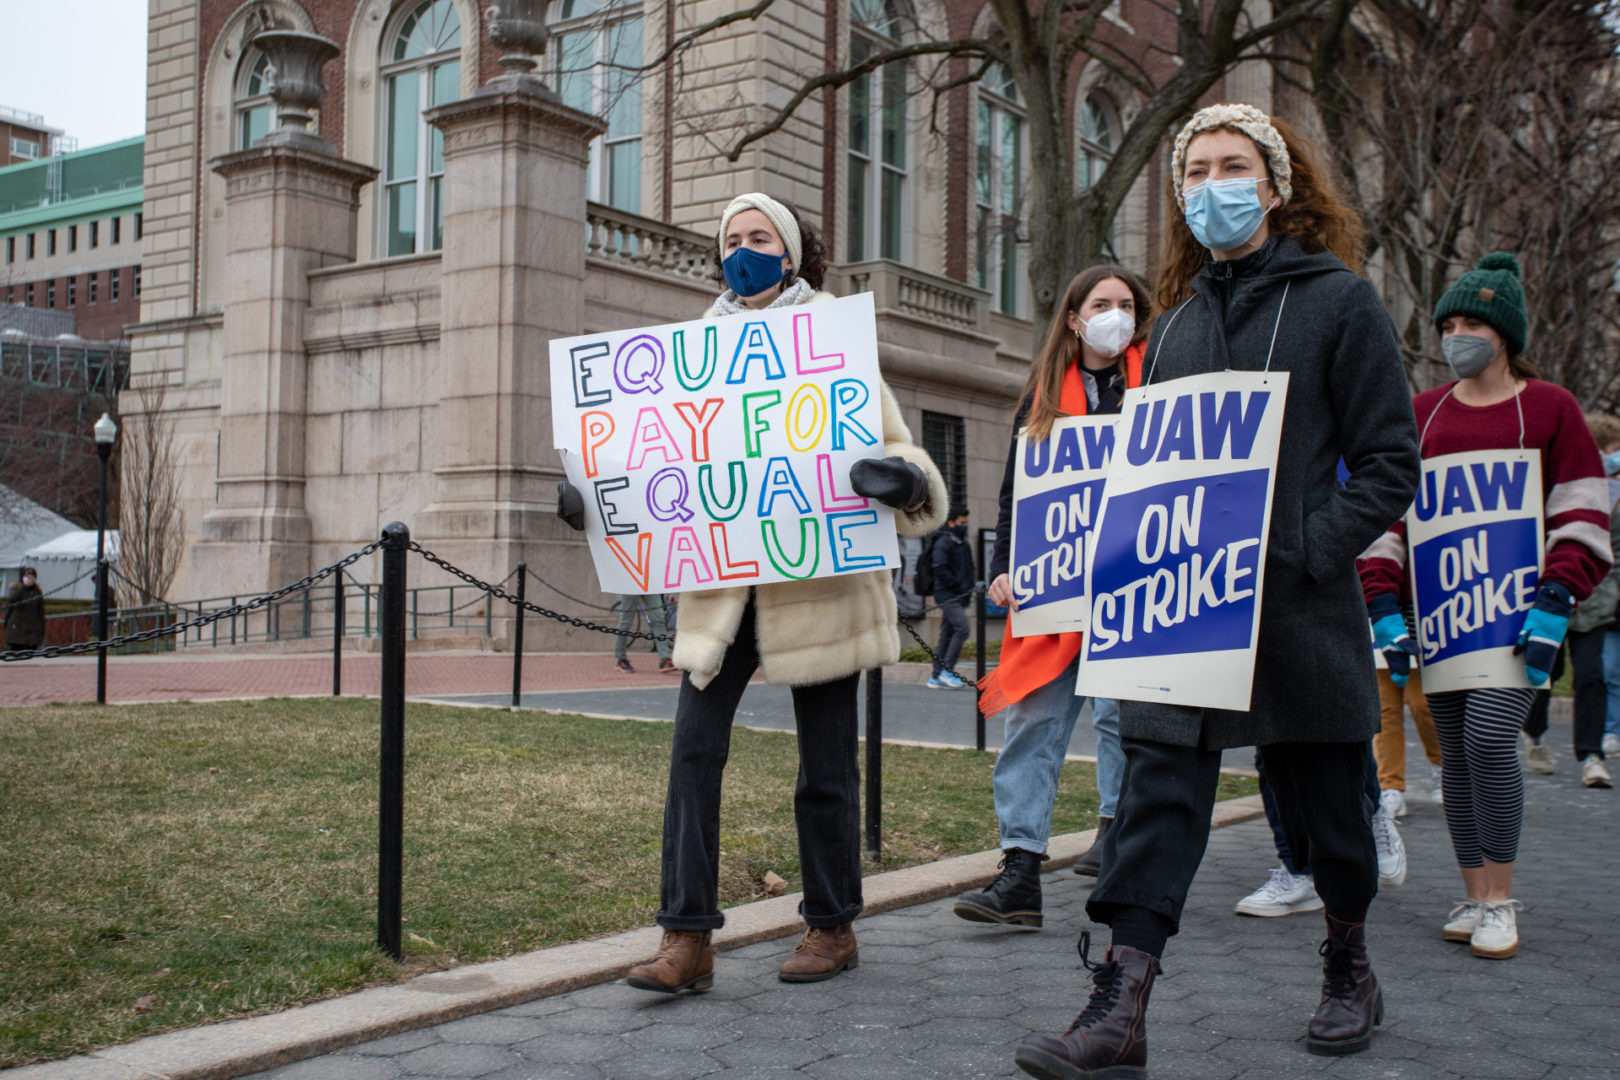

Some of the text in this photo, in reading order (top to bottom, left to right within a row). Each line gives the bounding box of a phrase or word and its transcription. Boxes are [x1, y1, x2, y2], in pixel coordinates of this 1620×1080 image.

[569, 313, 845, 408] EQUAL
[580, 378, 878, 480] PAY FOR
[1126, 391, 1271, 467] UAW
[593, 453, 869, 537] EQUAL
[1045, 486, 1092, 543] ON
[1136, 485, 1206, 565] ON
[1414, 461, 1529, 522] UAW
[604, 509, 886, 592] VALUE
[1439, 529, 1489, 592] ON
[1090, 537, 1261, 653] STRIKE
[1420, 566, 1539, 661] STRIKE
